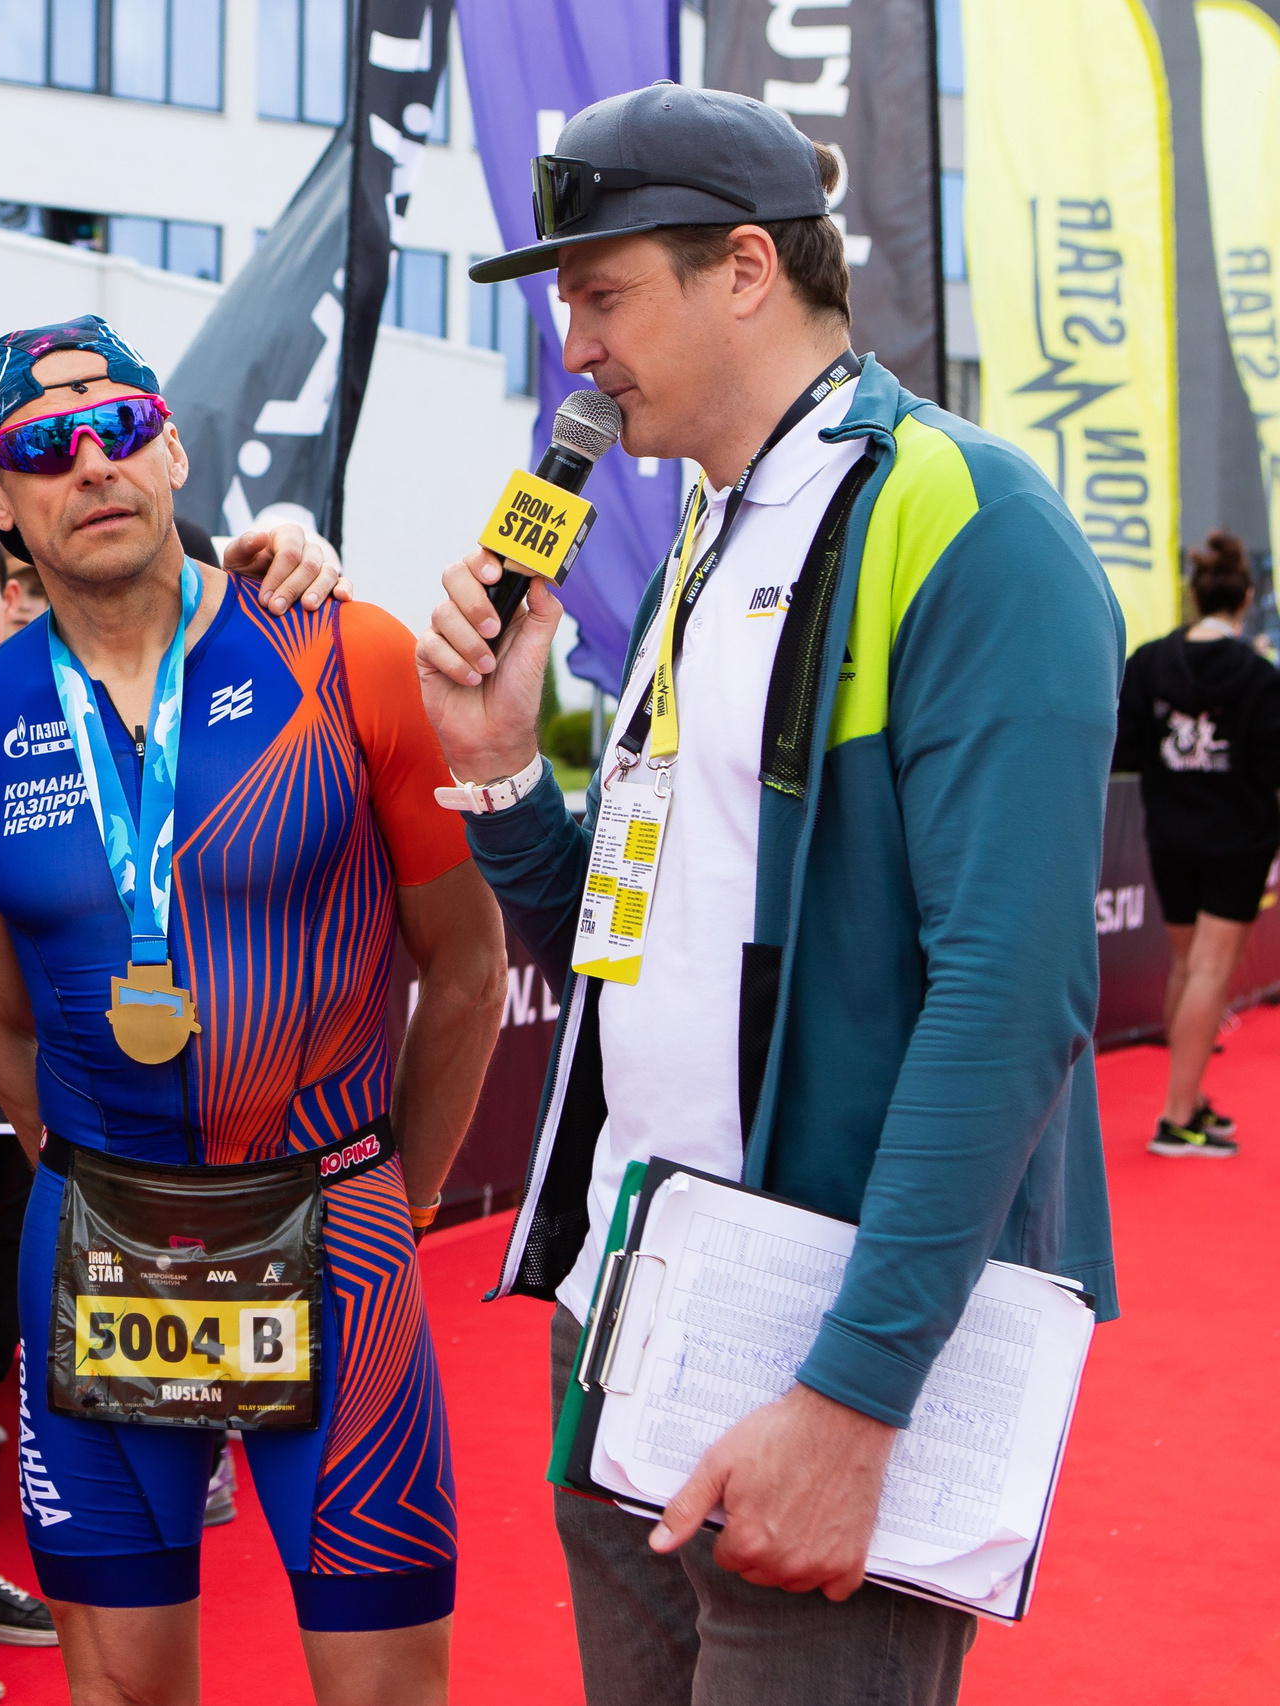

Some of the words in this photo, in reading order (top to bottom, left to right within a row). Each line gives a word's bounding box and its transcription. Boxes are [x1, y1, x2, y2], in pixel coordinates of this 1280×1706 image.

[811, 381, 832, 402] IRON
[830, 365, 848, 382] STAR
[511, 490, 554, 524] IRON
[498, 511, 559, 558] STAR
[686, 581, 702, 604] STAR
[749, 586, 783, 610] IRON
[657, 695, 665, 718] IRON
[29, 721, 68, 741] ГАЗПР
[34, 742, 66, 754] НЕФ
[4, 773, 86, 800] КОМАНД
[3, 809, 74, 836] НЕФТИ
[580, 919, 596, 935] STAR
[88, 1251, 112, 1264] IRON
[88, 1265, 123, 1283] STAR
[140, 1272, 188, 1281] ГАЗПРОМБАНК
[148, 1278, 180, 1286] ПРЕМИУМ
[206, 1270, 238, 1283] AVA
[88, 1312, 226, 1365] 5004
[252, 1317, 284, 1364] B
[161, 1385, 222, 1402] RUSLAN
